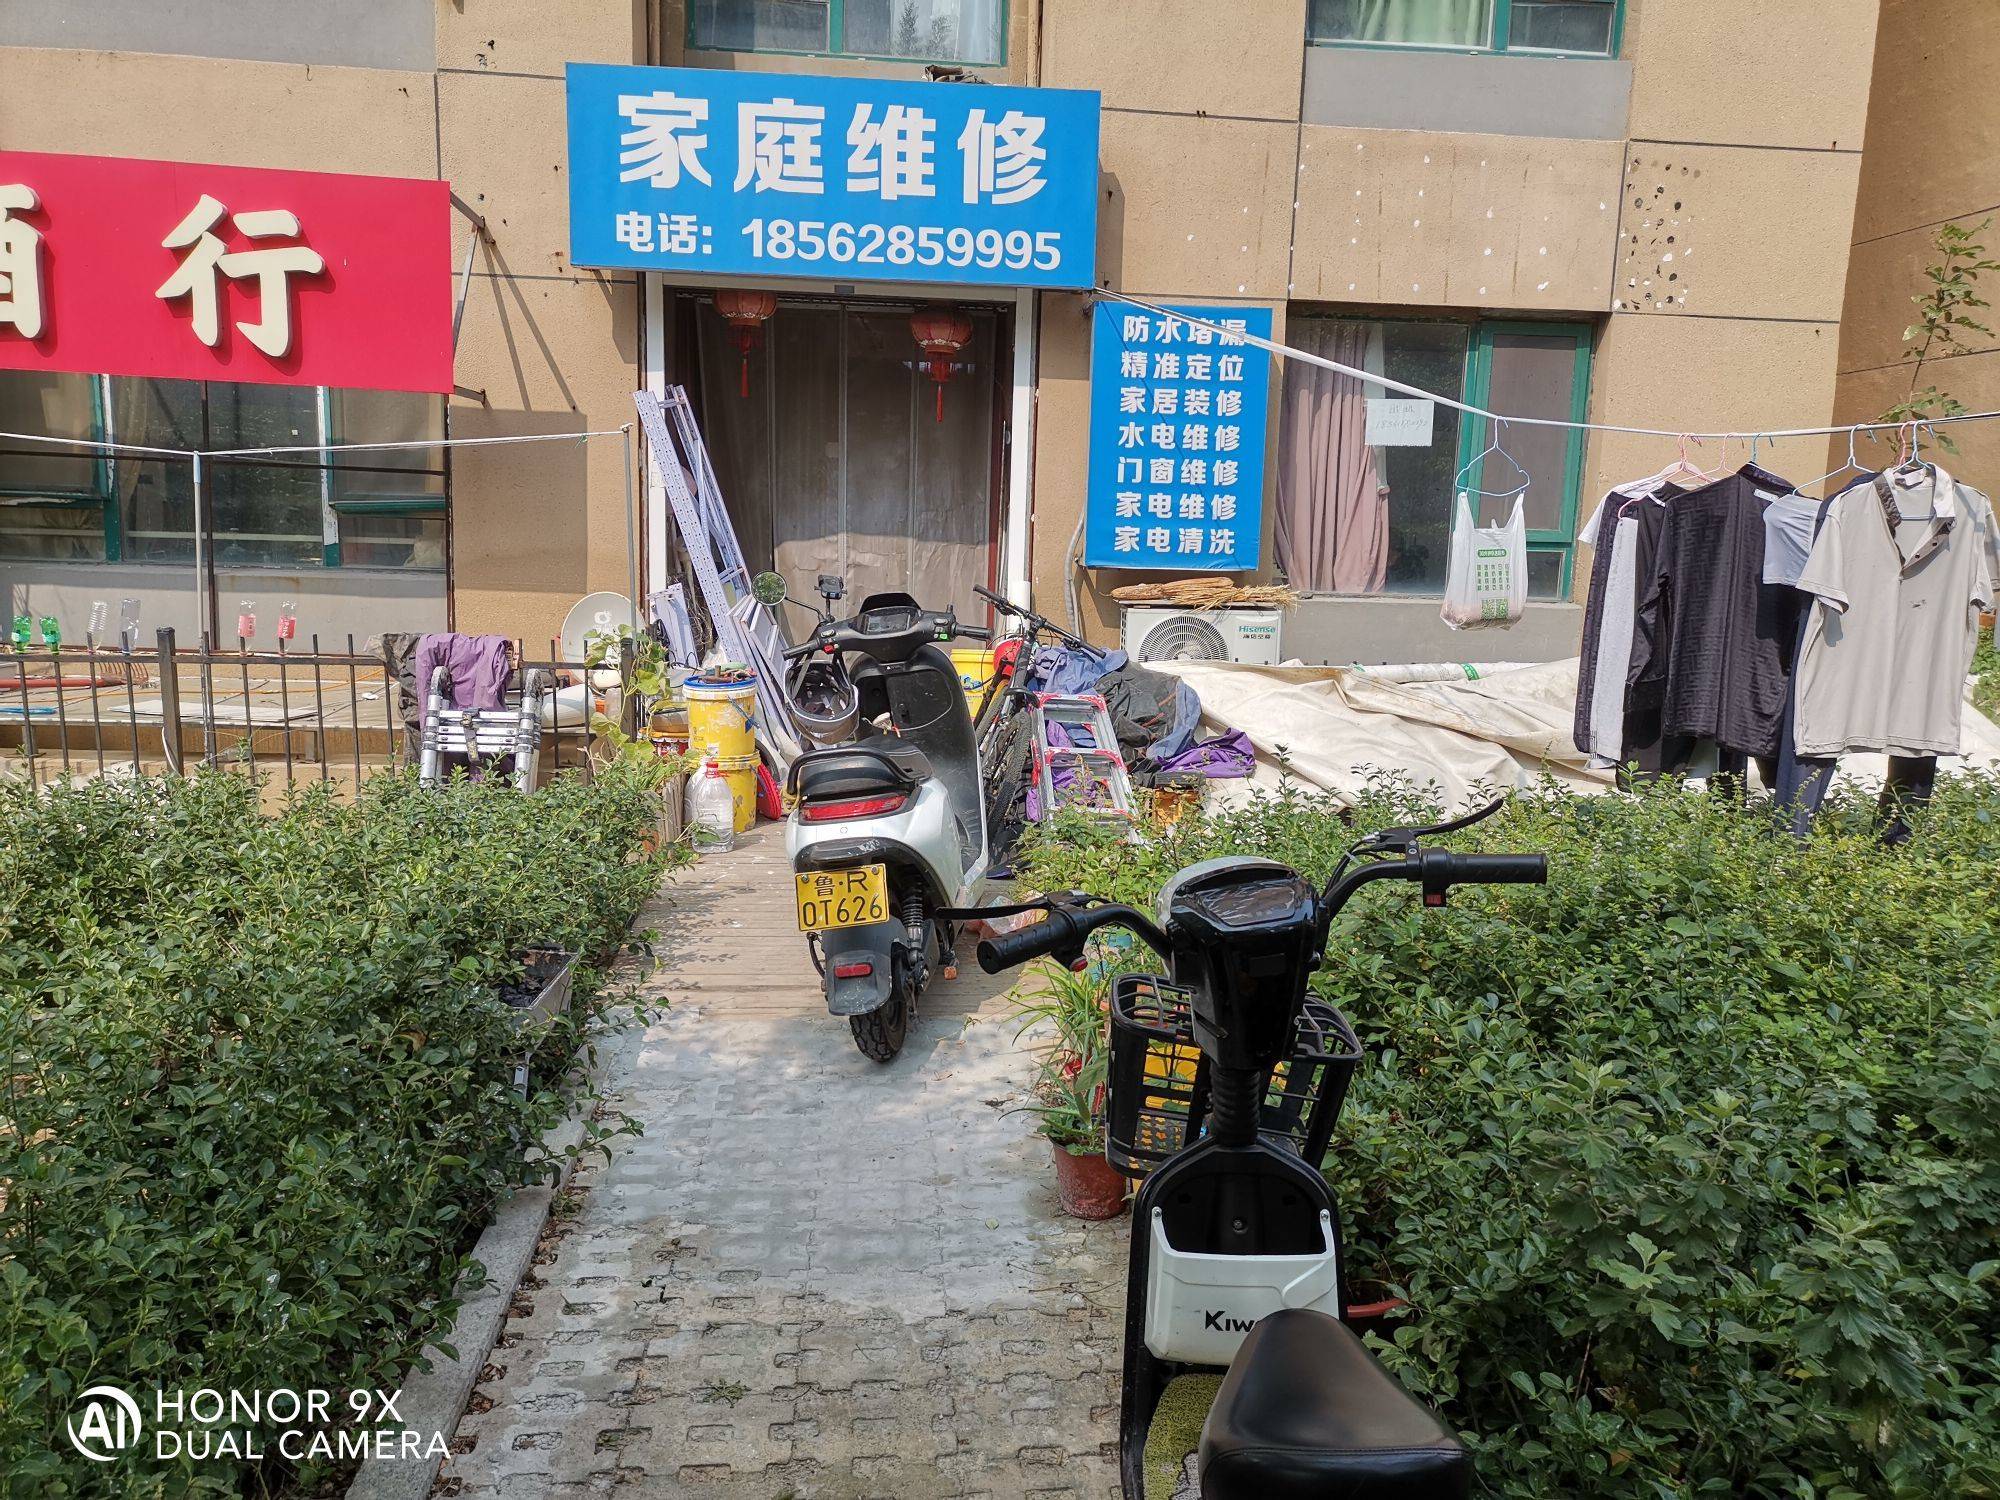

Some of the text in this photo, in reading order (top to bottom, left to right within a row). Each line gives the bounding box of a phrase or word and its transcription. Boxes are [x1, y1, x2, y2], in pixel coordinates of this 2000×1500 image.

[618, 91, 1047, 205] 家庭维修
[741, 217, 1062, 271] 18562859995
[1120, 350, 1244, 382] 精准定位
[1119, 386, 1242, 417] 家居装修
[1118, 421, 1241, 452] 水电维修
[1116, 456, 1239, 487] 门窗维修
[1115, 491, 1238, 521] 家电维修
[1113, 525, 1236, 555] 家电清洗
[1238, 625, 1276, 633] Hisense
